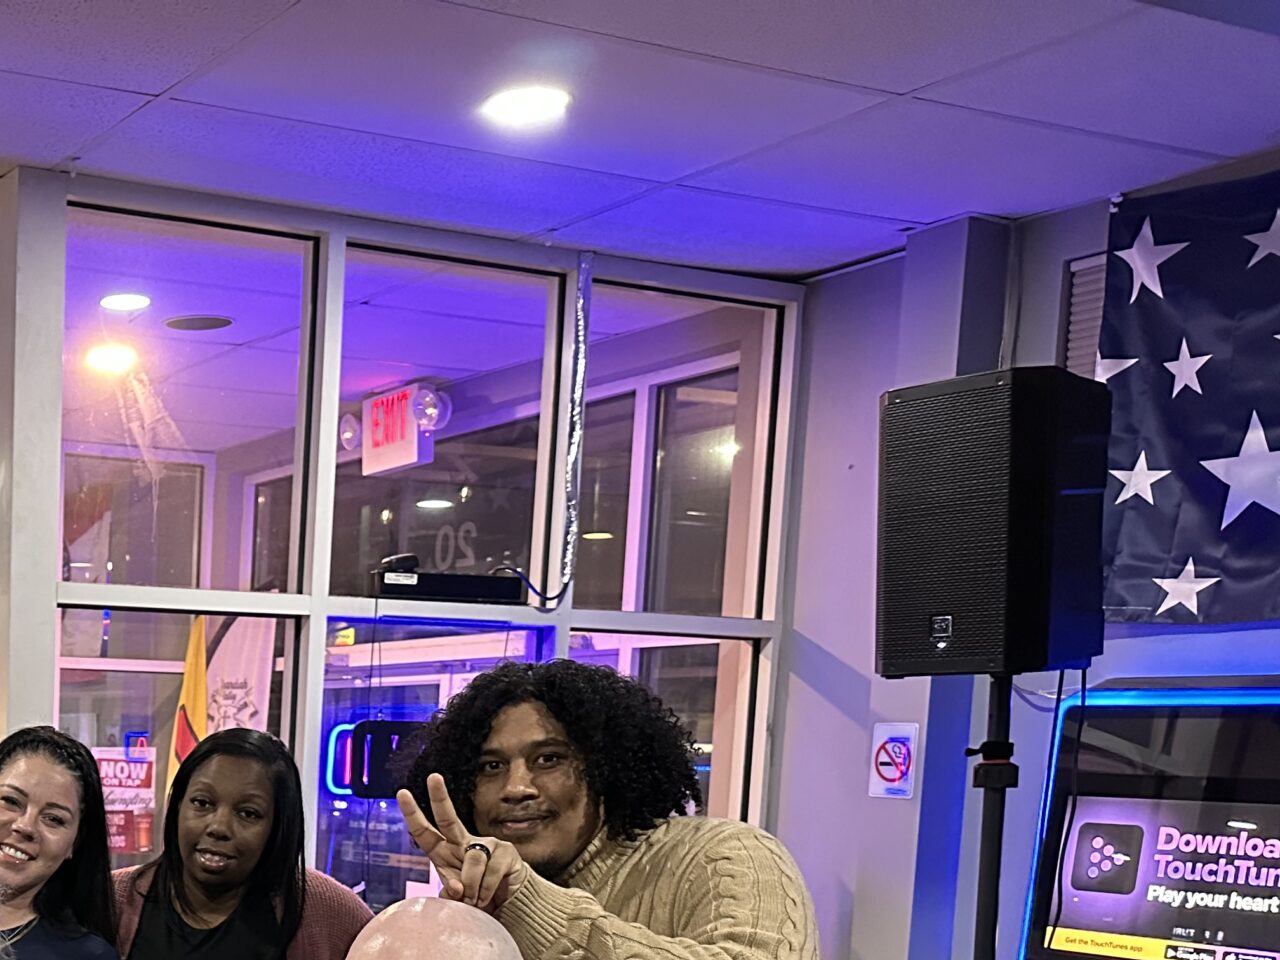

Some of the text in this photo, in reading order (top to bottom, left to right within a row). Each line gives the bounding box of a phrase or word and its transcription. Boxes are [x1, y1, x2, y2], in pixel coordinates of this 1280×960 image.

[371, 389, 412, 448] EXIT
[100, 760, 149, 780] NOW
[103, 777, 142, 787] ON TAP
[1156, 826, 1280, 860] Downloa
[1153, 854, 1280, 888] TouchTun
[1146, 885, 1280, 913] Play your heart
[1065, 936, 1143, 954] Get the TouchTunes app
